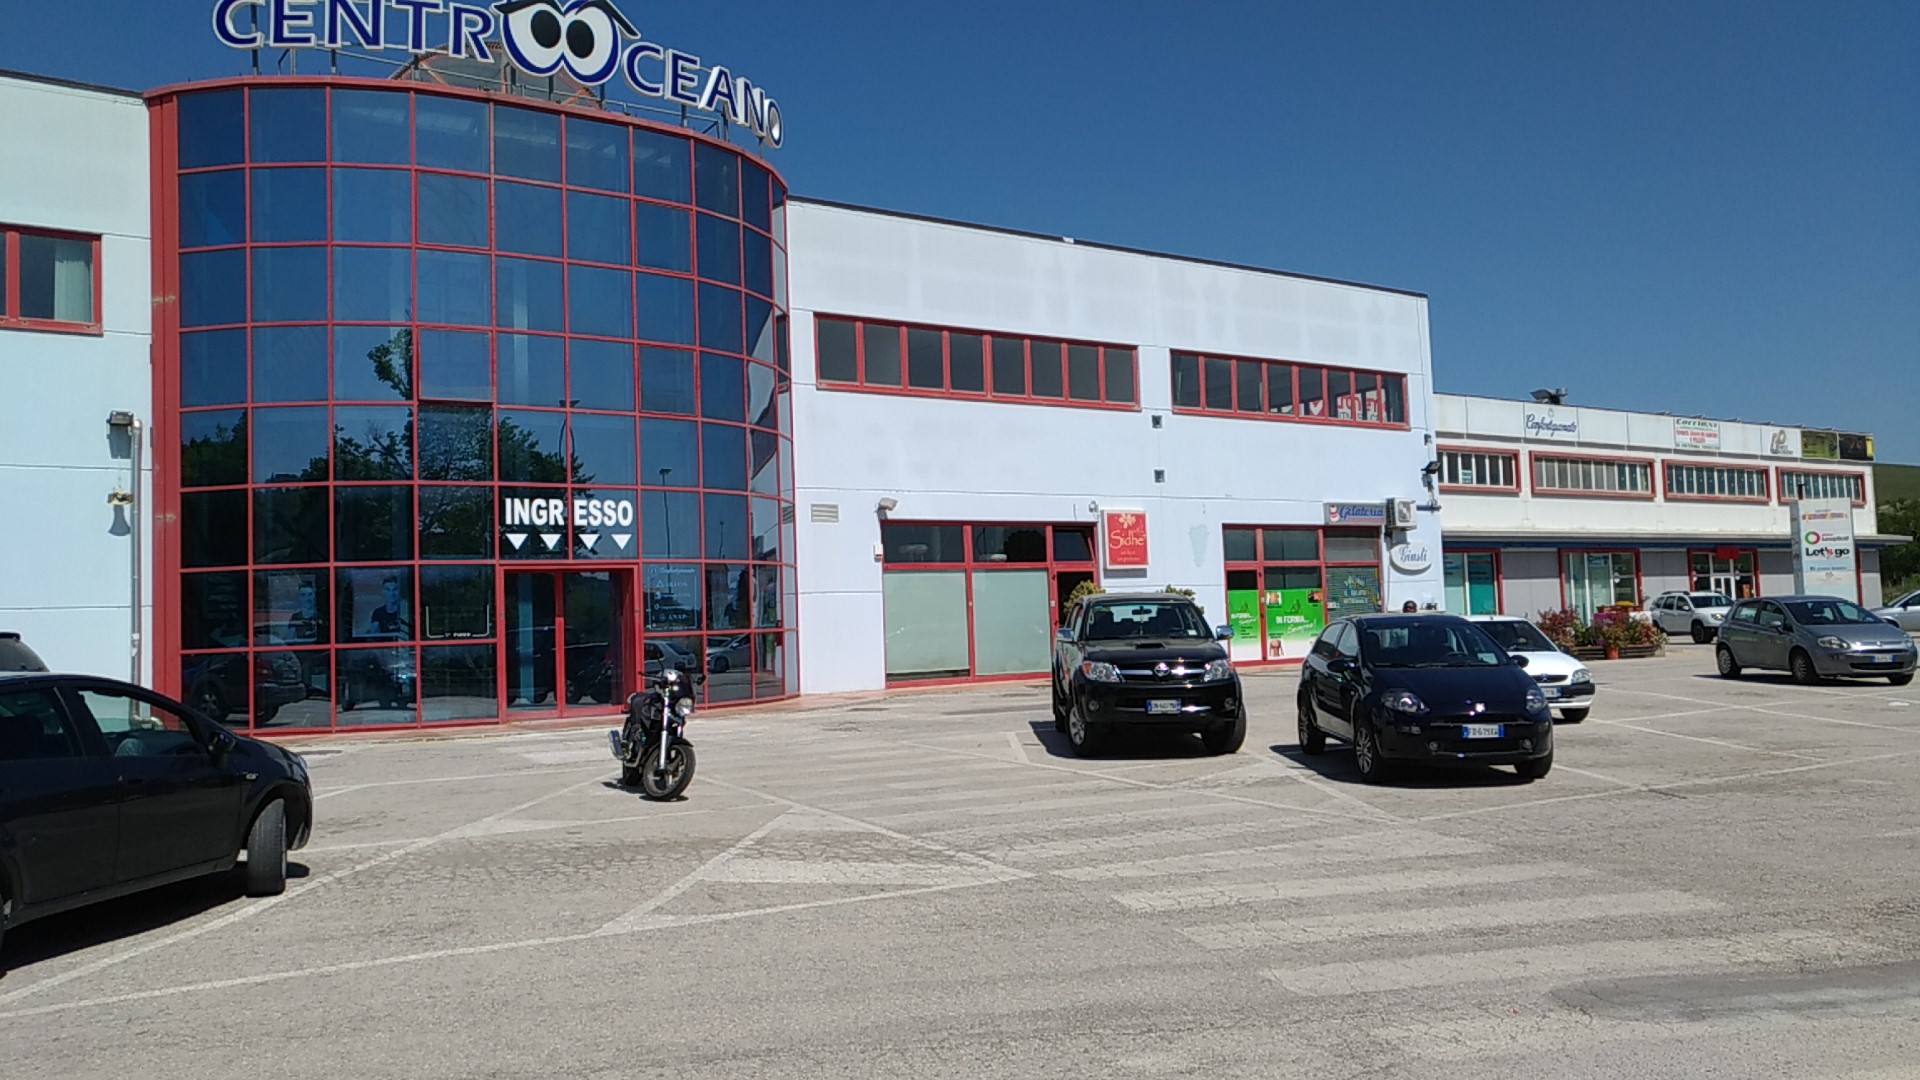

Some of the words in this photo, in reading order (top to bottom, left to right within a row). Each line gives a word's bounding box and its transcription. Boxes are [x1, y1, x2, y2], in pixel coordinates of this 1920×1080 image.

[1340, 504, 1384, 519] Gelateria
[1805, 547, 1833, 557] Let's
[1834, 548, 1850, 558] go
